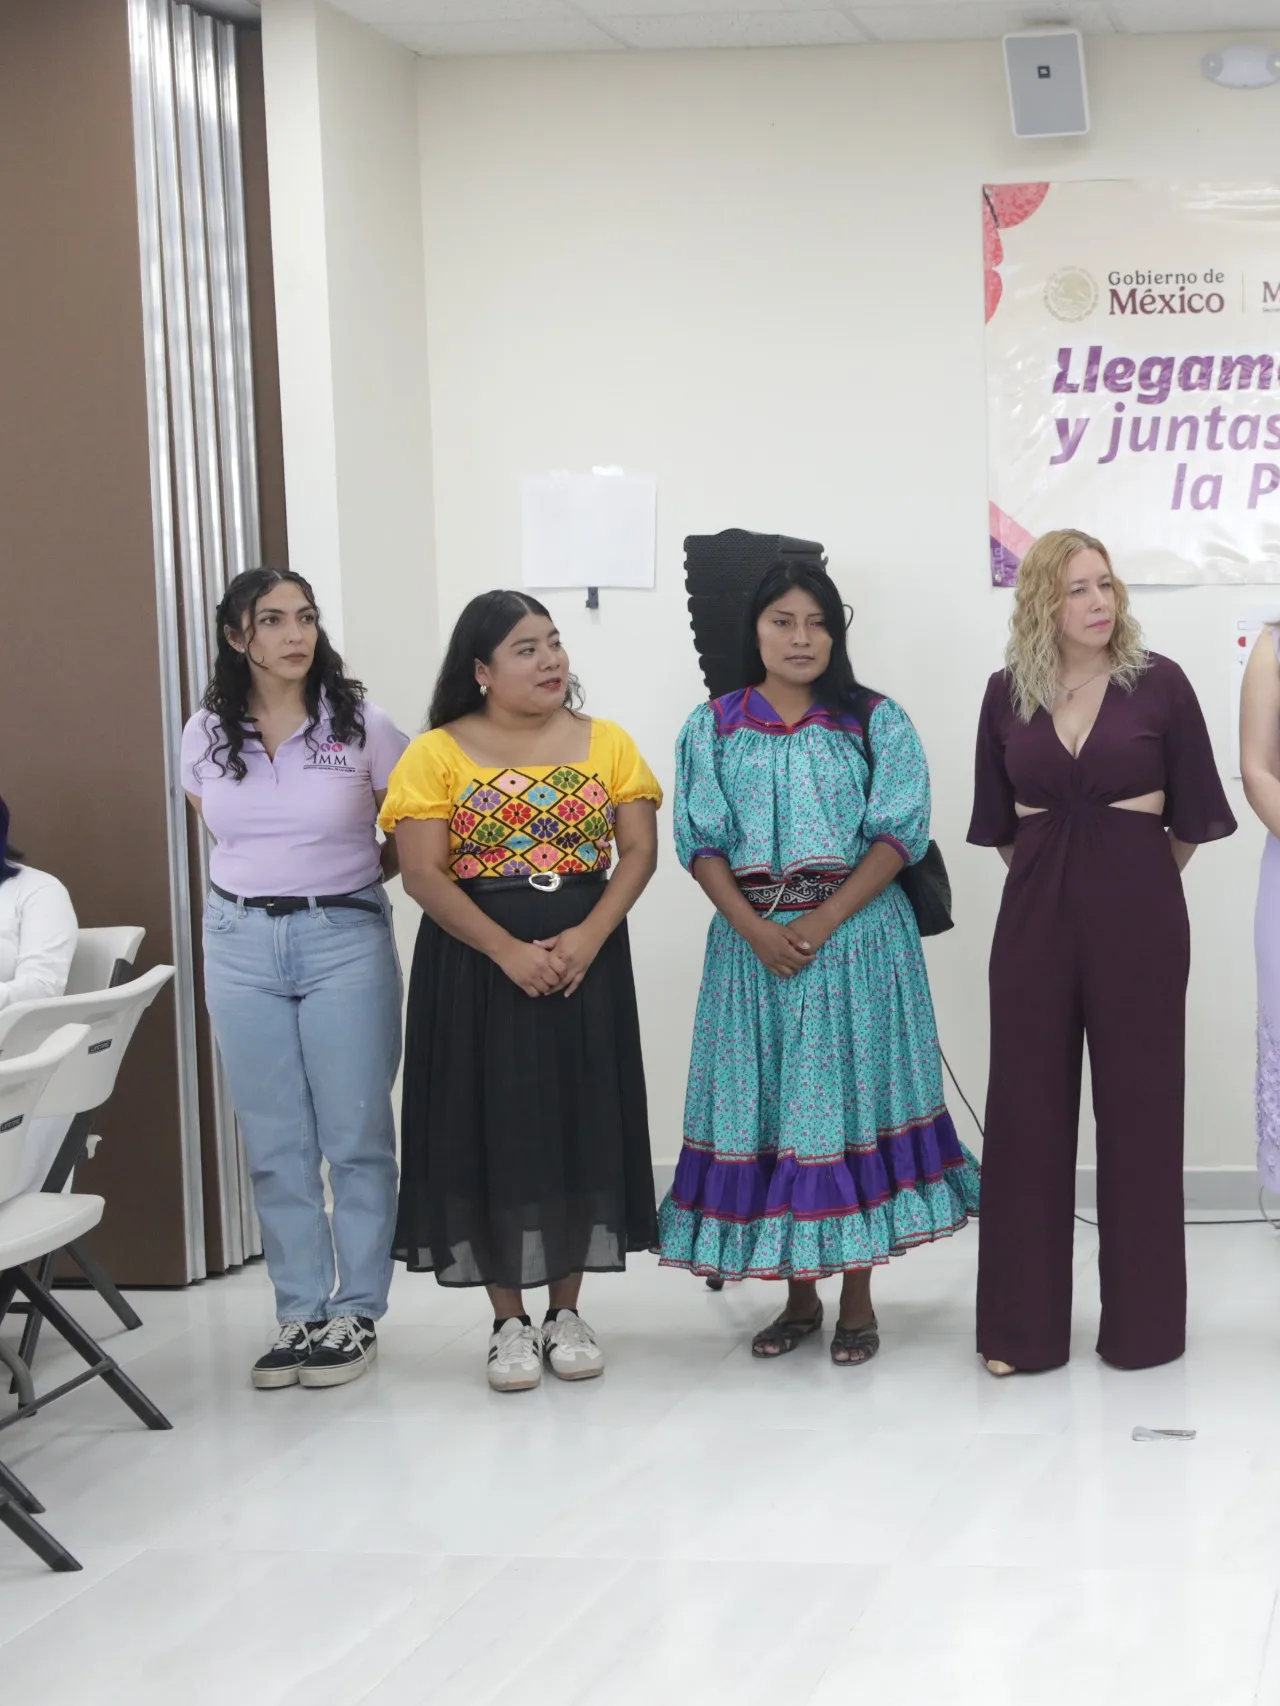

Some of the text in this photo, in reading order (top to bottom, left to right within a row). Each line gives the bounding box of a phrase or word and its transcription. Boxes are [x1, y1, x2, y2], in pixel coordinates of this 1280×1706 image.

[1108, 270, 1197, 286] Gobierno
[1203, 269, 1225, 284] de
[1108, 286, 1225, 316] México
[1049, 417, 1090, 465] y
[1171, 463, 1223, 511] la
[312, 754, 347, 765] IMM
